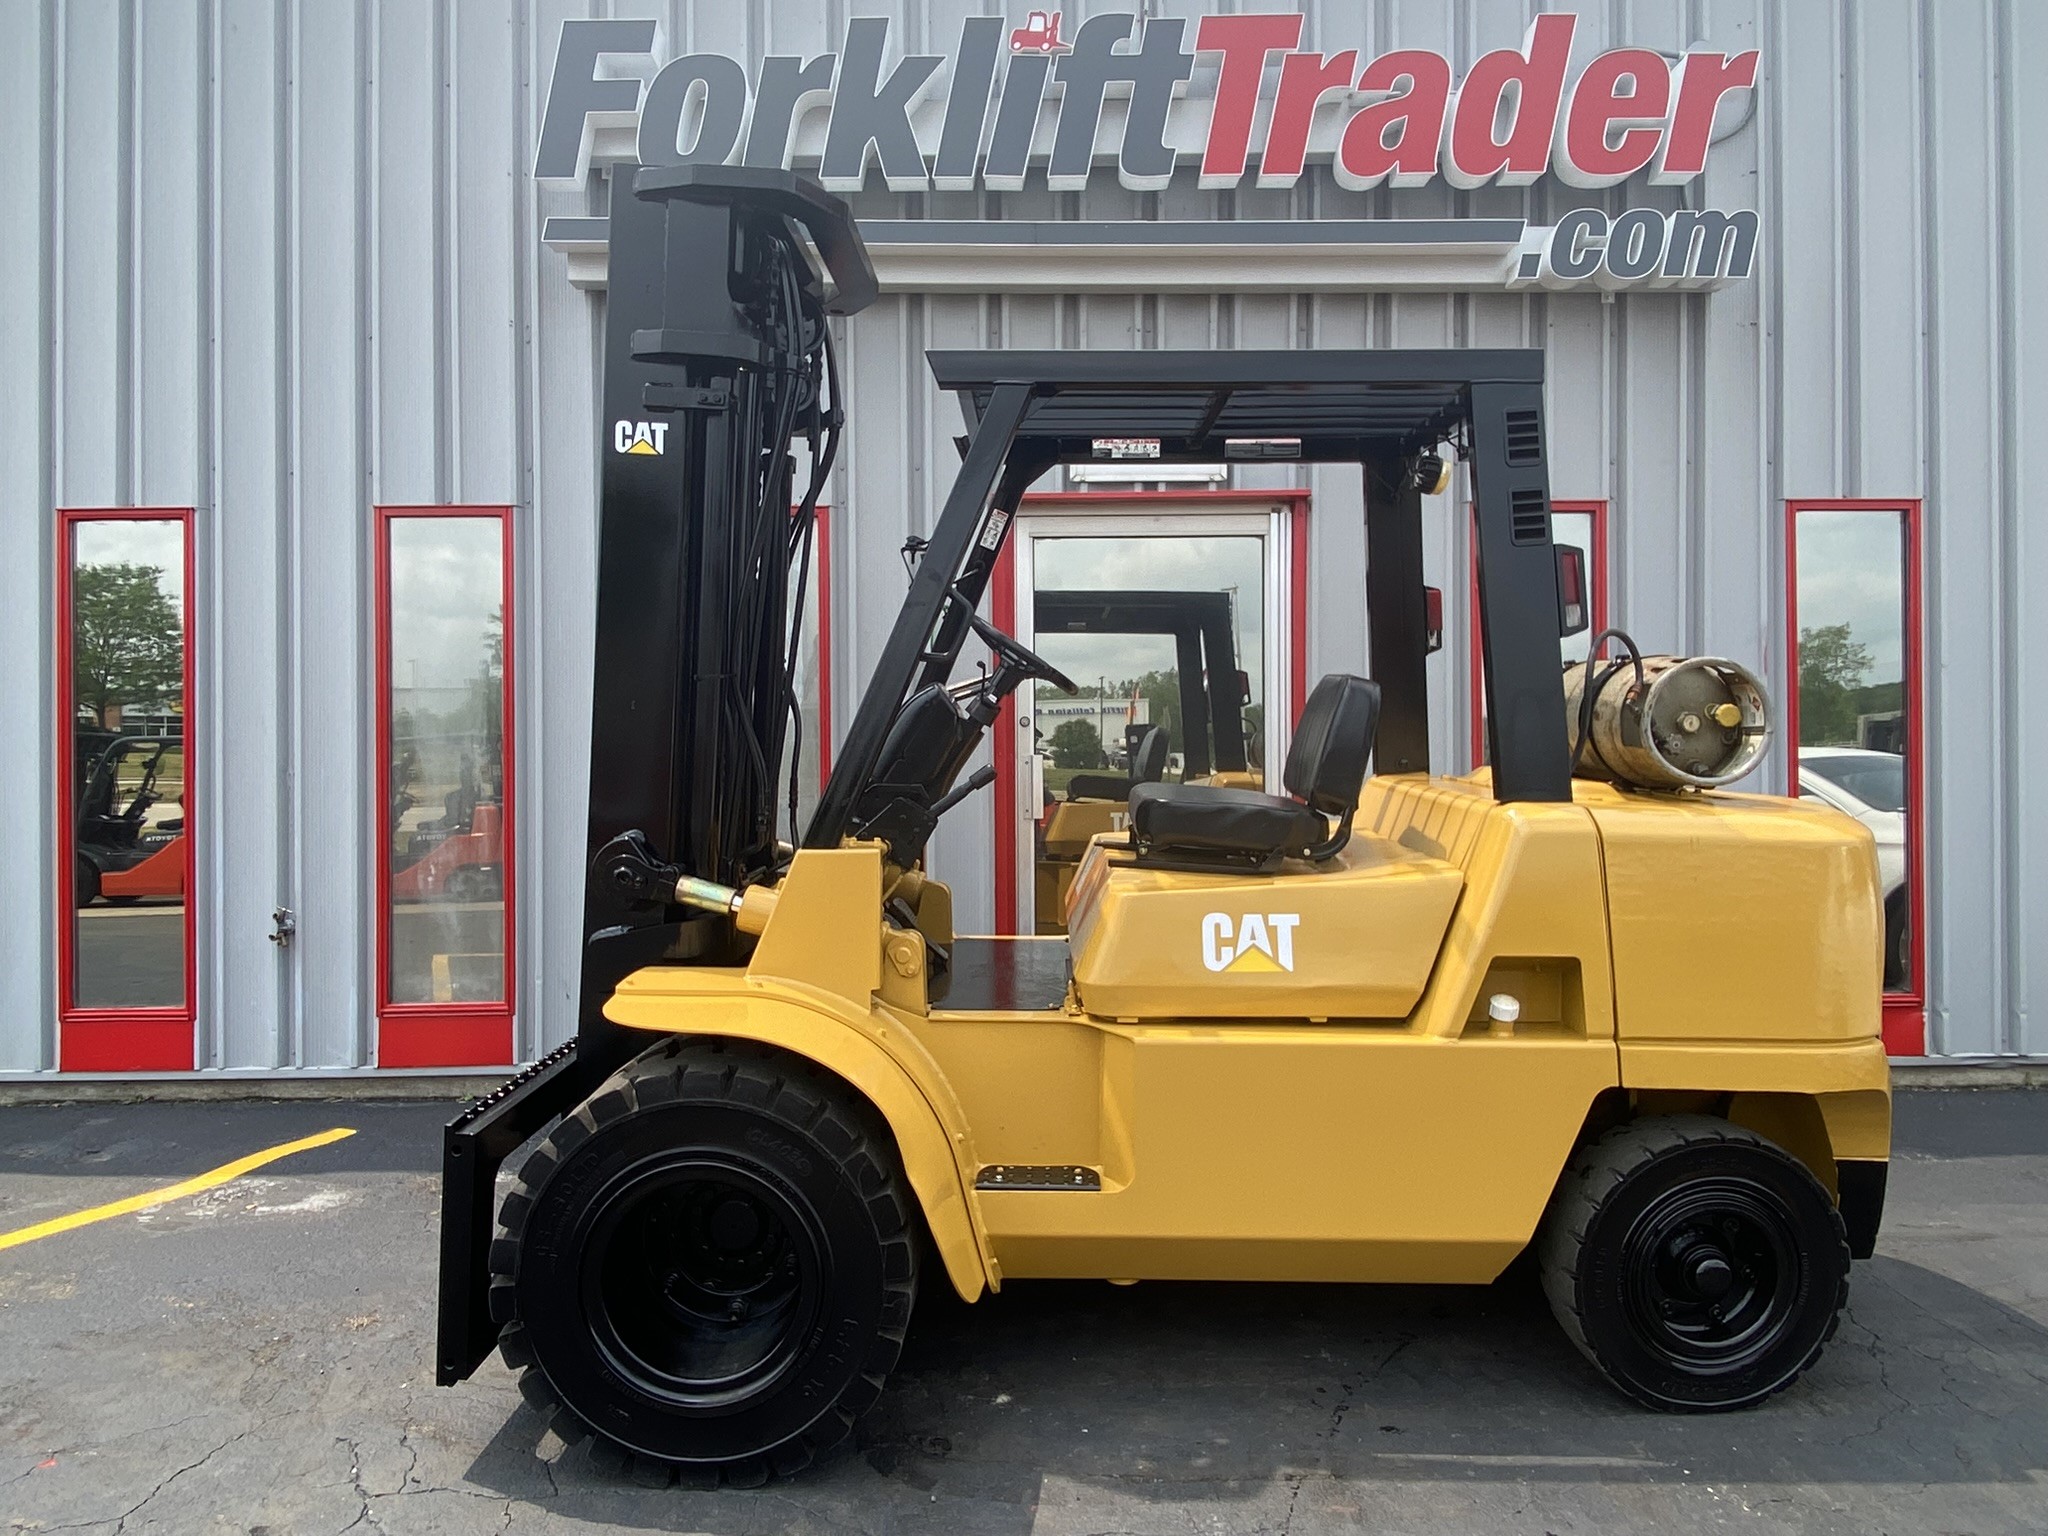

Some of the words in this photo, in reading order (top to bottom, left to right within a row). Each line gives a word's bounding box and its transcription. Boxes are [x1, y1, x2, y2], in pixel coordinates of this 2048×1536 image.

[1516, 207, 1760, 281] .com
[614, 420, 669, 455] CAT
[1202, 912, 1300, 972] CAT
